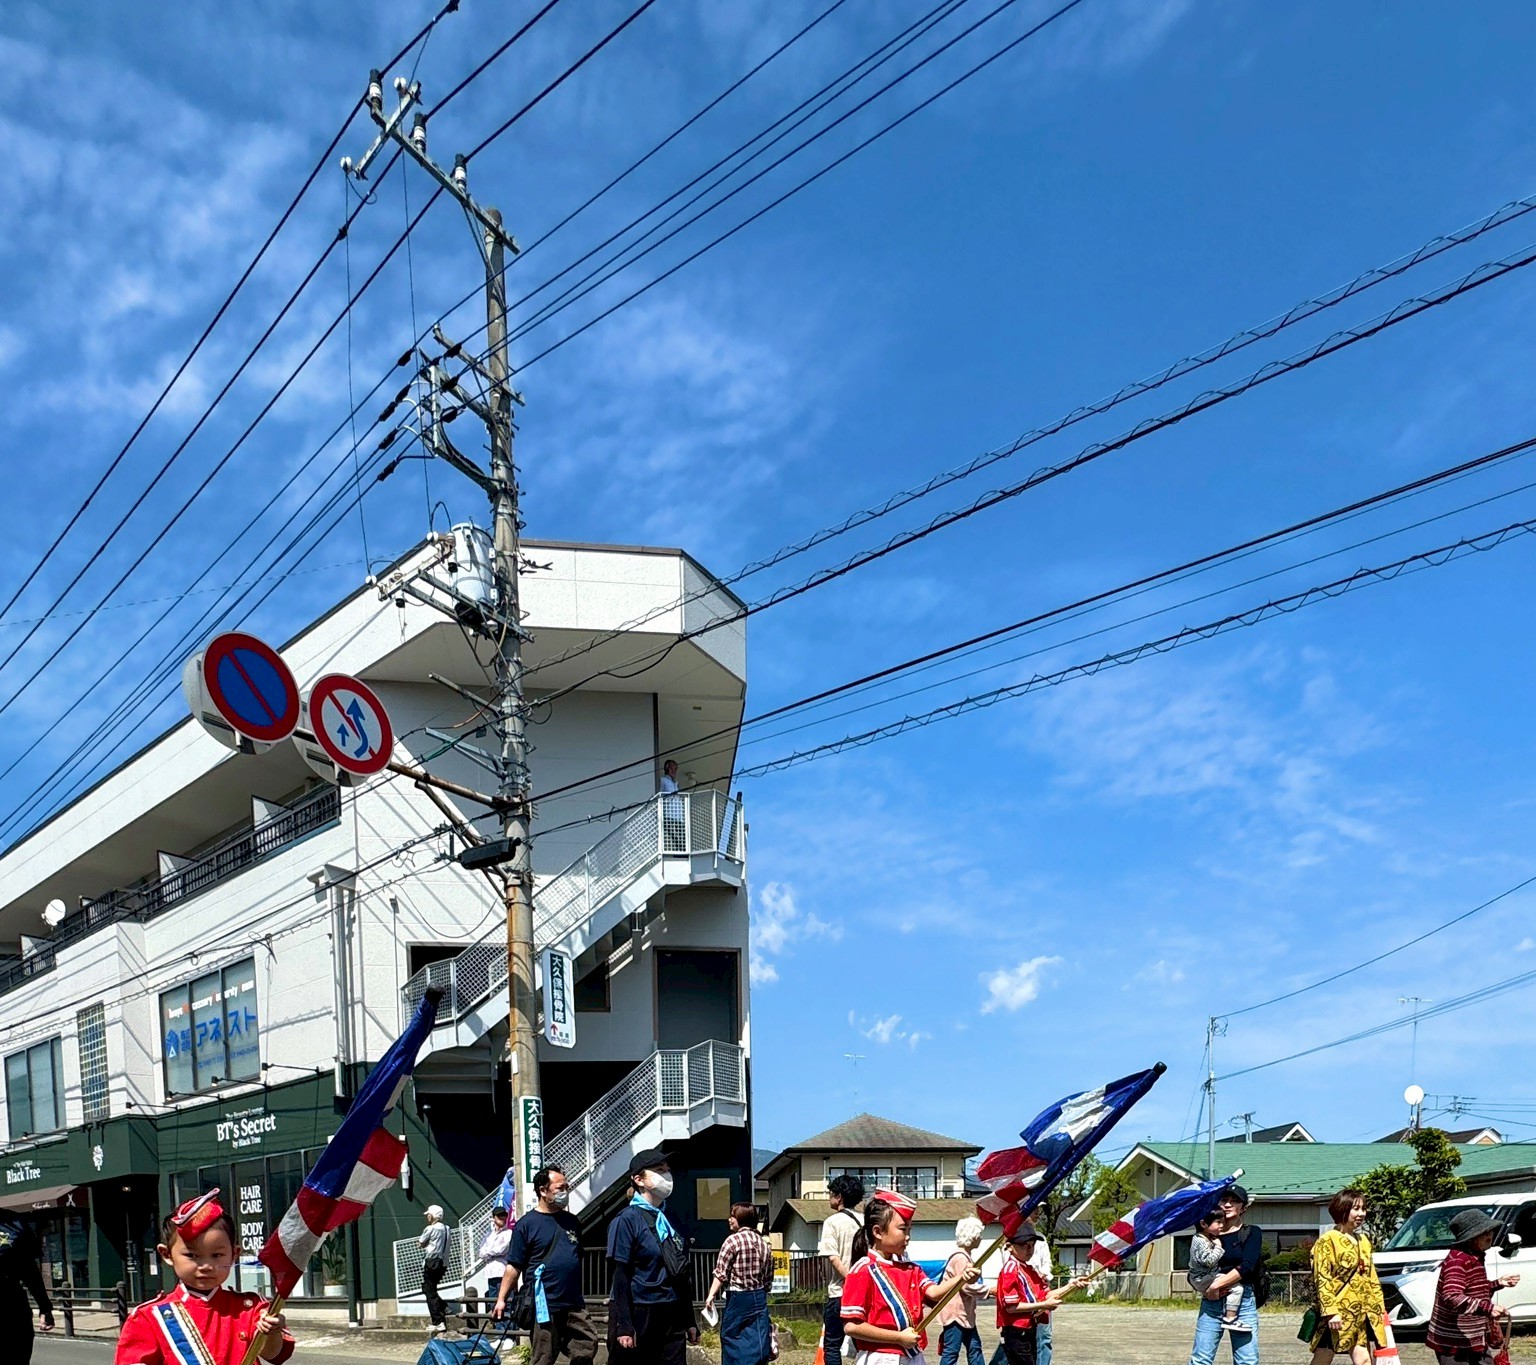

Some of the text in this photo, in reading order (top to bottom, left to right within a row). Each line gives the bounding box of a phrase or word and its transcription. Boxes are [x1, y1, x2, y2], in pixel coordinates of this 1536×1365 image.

[552, 955, 565, 1022] 大久保接骨院
[216, 1113, 277, 1142] BT's Secret
[6, 1166, 41, 1184] Black Tree
[240, 1184, 261, 1200] HAIR
[240, 1199, 263, 1215] CARE
[241, 1221, 264, 1237] BODY
[242, 1236, 264, 1251] CARE
